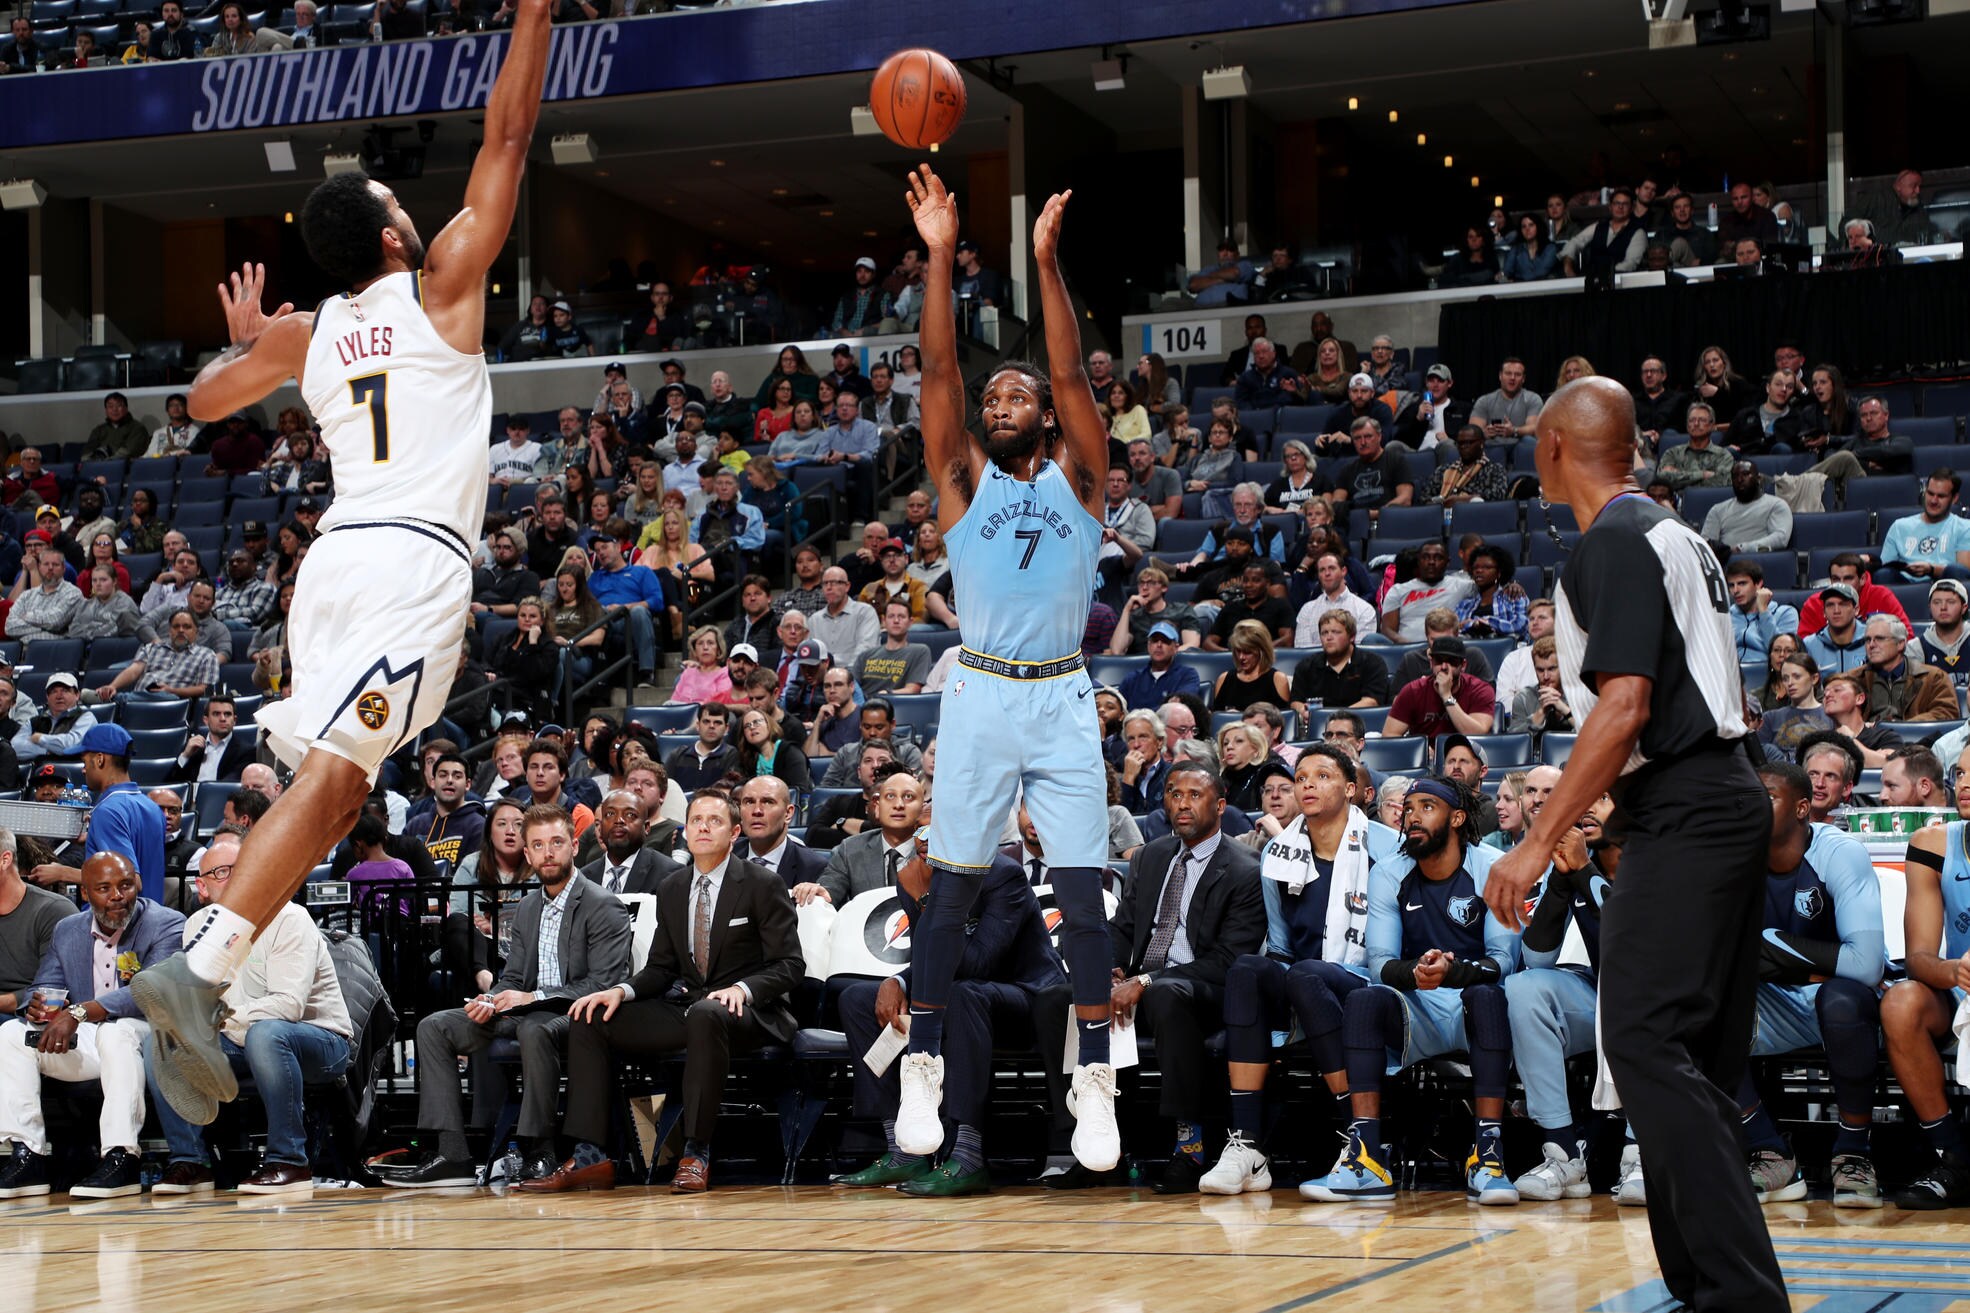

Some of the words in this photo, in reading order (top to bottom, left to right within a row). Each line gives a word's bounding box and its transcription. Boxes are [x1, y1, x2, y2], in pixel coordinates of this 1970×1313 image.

[192, 42, 432, 131] SOUTHLAND
[440, 23, 620, 111] GAING
[335, 326, 393, 367] LYLES
[1162, 326, 1207, 353] 104
[346, 370, 391, 464] 7
[980, 499, 1073, 541] GRIZZLIES
[1014, 529, 1043, 570] 7
